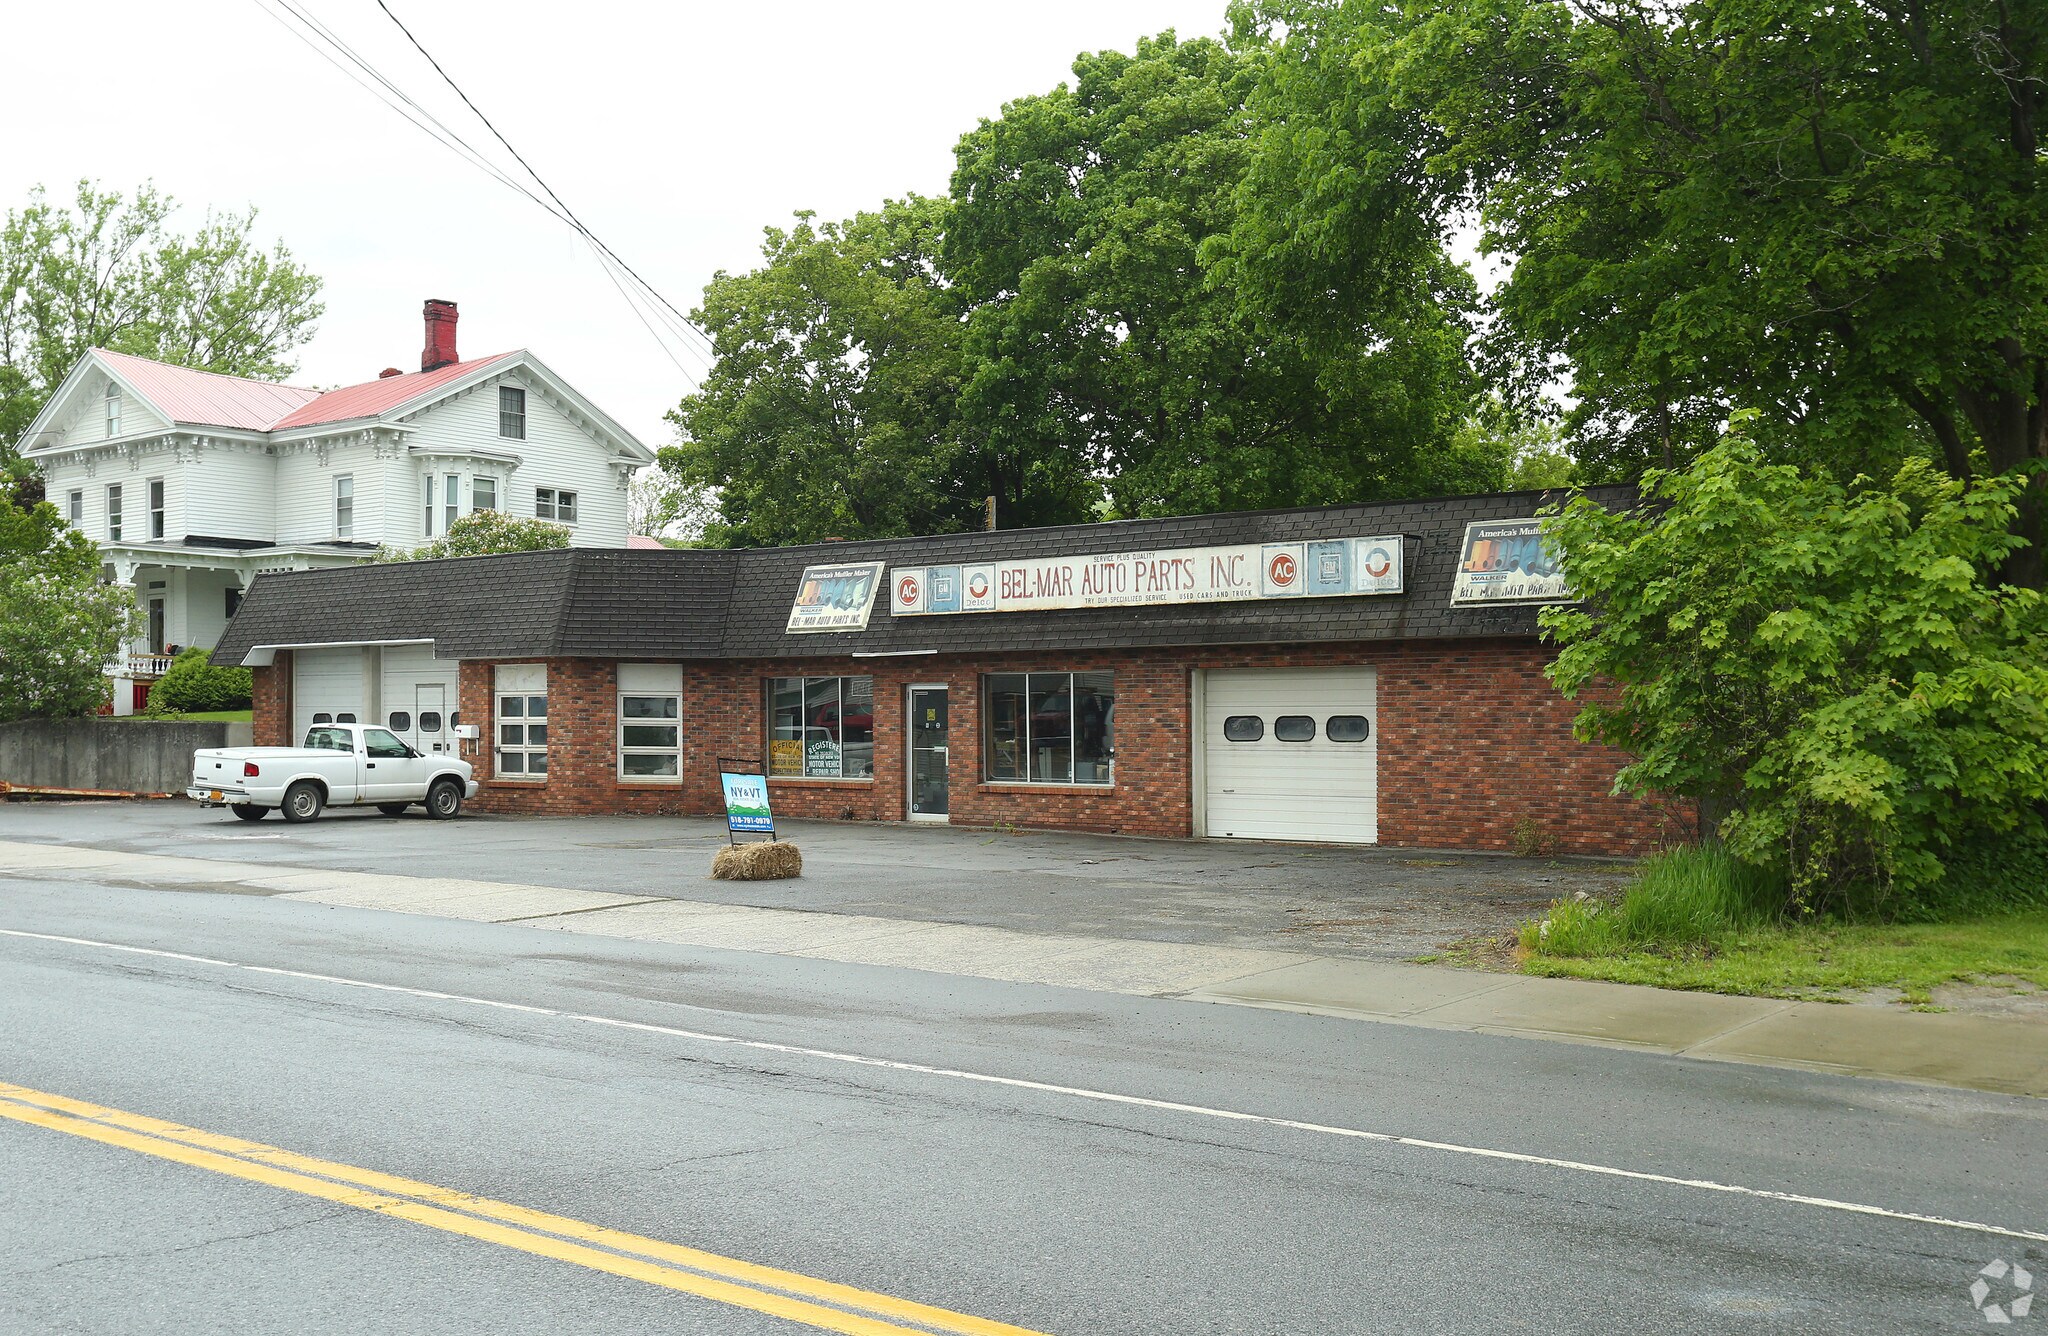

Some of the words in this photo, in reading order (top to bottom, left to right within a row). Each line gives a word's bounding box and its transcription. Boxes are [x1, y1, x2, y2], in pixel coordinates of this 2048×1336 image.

[1478, 527, 1517, 538] America's
[1093, 555, 1114, 563] SERVICE
[1116, 553, 1130, 561] PLUS
[1133, 552, 1156, 560] QUALITY
[1274, 562, 1294, 578] AC
[1324, 561, 1336, 572] GM
[833, 570, 853, 578] Muffler
[853, 569, 871, 577] Maker
[1001, 566, 1073, 599] BEL-MAR
[1081, 562, 1126, 595] AUTO
[1135, 557, 1195, 592] PARTS
[1210, 554, 1252, 588] INC.
[902, 583, 917, 598] AC
[1197, 591, 1213, 599] CARS
[1216, 590, 1229, 598] AND
[1097, 596, 1108, 604] OUR
[1110, 595, 1142, 604] SPECIALIZED
[1145, 594, 1167, 602] SERVICE
[791, 616, 816, 627] BEL-MAR
[816, 615, 832, 625] AUTO
[831, 614, 850, 625] PARTS
[808, 760, 825, 768] MOTOR
[812, 768, 829, 776] REPAIR
[730, 786, 760, 798] NY&VT
